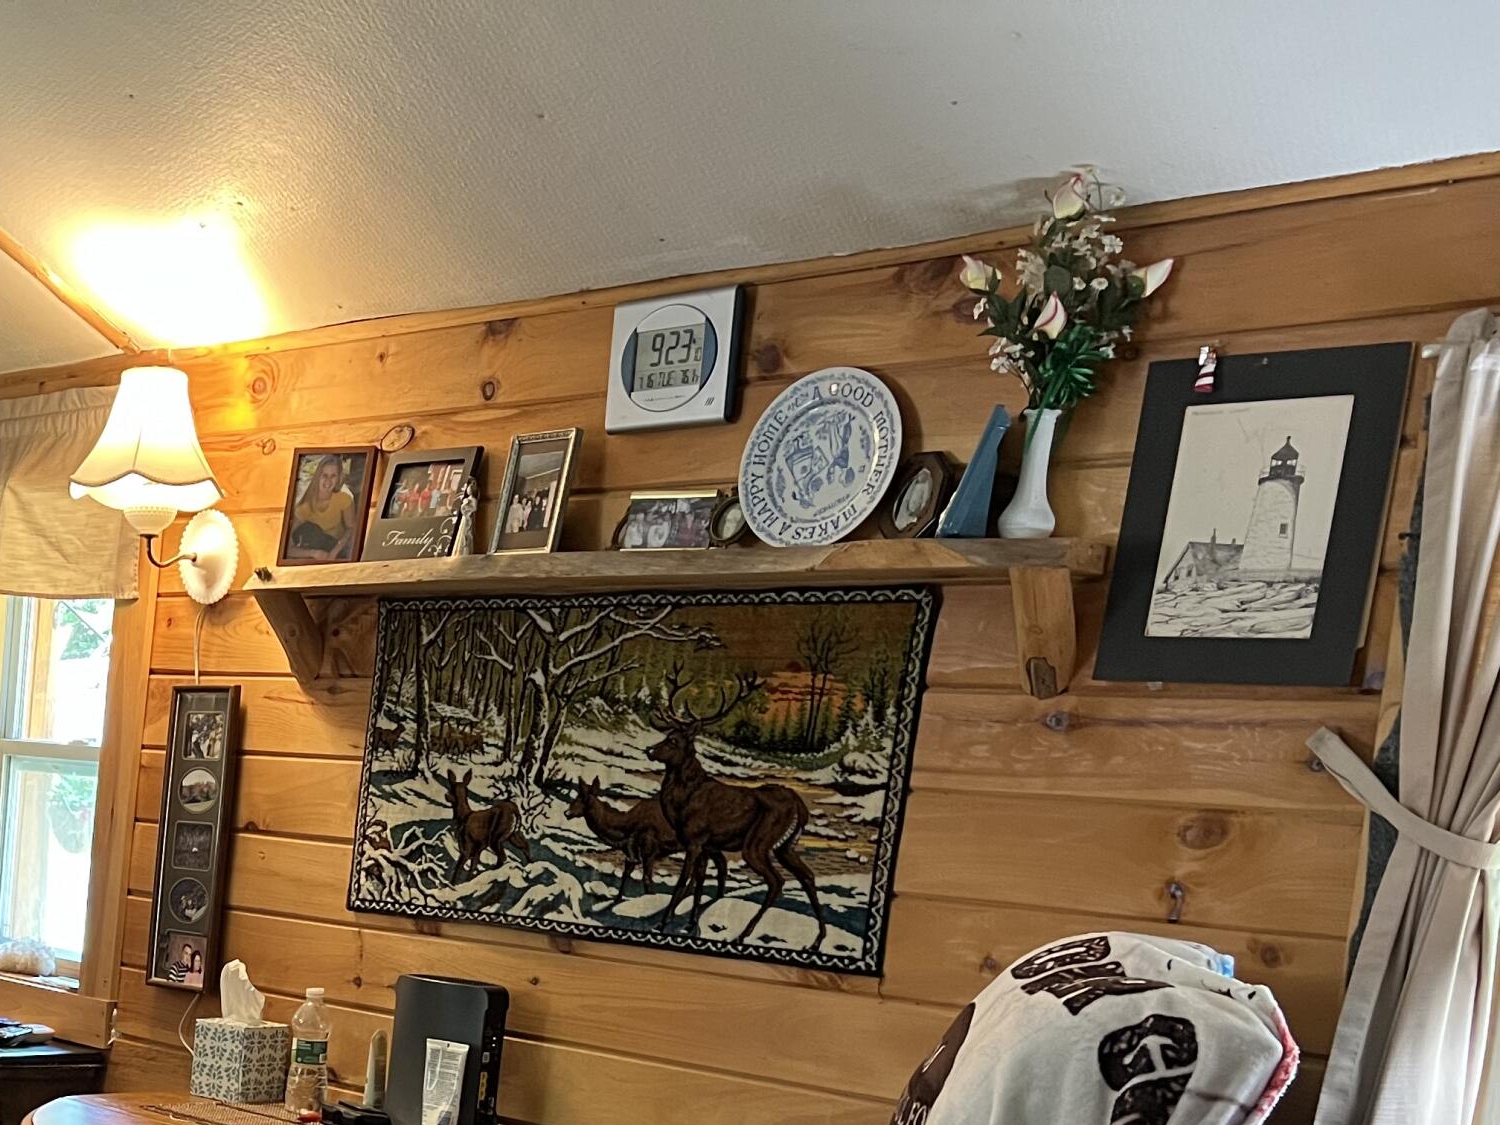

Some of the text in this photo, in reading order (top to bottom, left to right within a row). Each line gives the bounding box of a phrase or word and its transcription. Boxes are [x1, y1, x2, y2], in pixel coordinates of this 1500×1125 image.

[812, 385, 823, 401] A
[828, 382, 875, 408] GOOD
[752, 409, 789, 467] HOME
[861, 410, 892, 497] MOTHER
[749, 472, 780, 529] HAPPY
[778, 522, 793, 536] A
[791, 503, 859, 541] MAKES
[381, 528, 435, 558] Family
